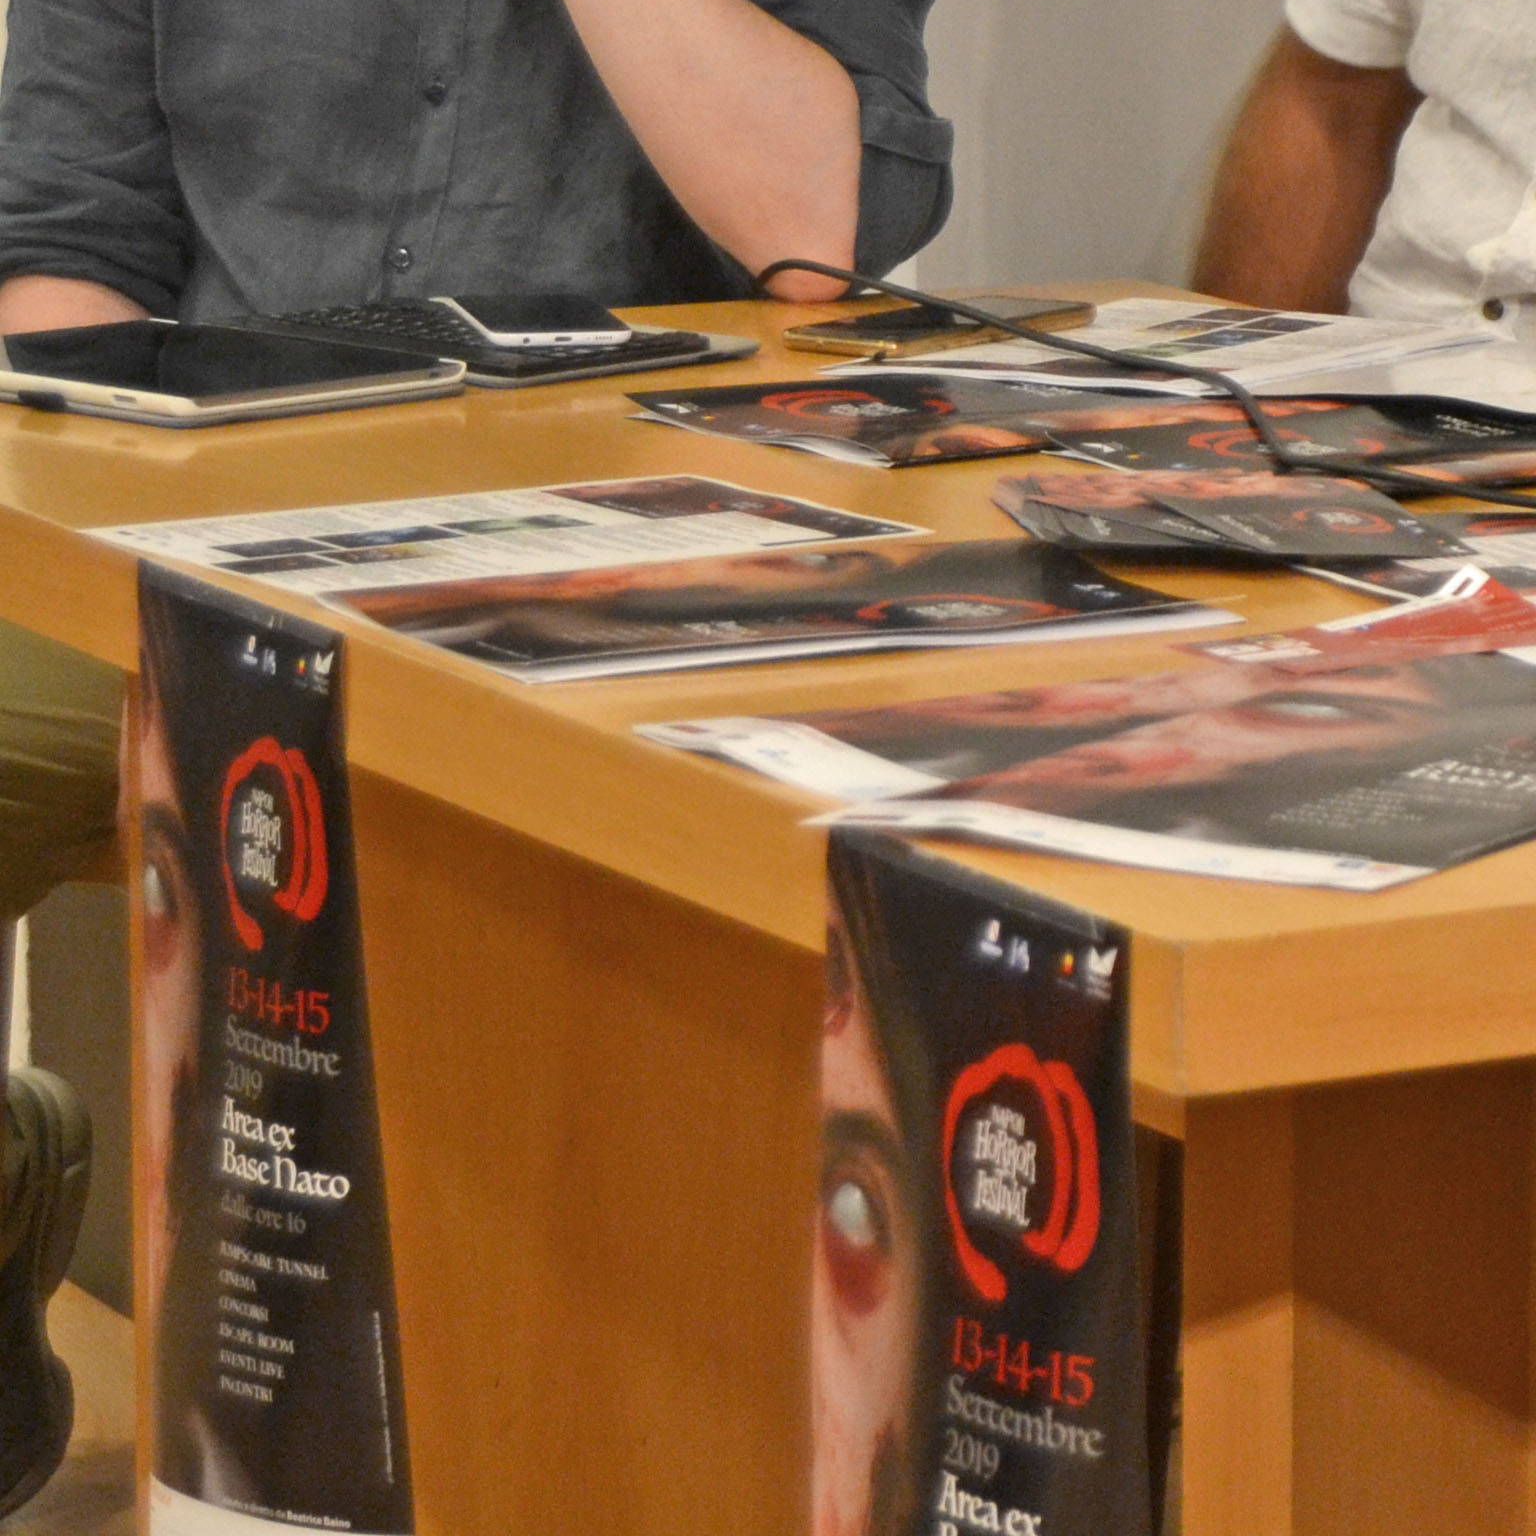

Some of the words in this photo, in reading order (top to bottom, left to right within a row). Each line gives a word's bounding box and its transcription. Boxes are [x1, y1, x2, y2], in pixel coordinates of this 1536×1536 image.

[228, 967, 331, 1035] 13-14-15
[225, 1014, 341, 1077] Settembre
[223, 1059, 263, 1100] 2019
[222, 1094, 264, 1143] Area
[268, 1122, 296, 1152] ex
[222, 1137, 270, 1186] Base
[274, 1155, 350, 1200] Nato
[256, 1208, 283, 1230] ore
[286, 1212, 307, 1235] 16
[218, 1268, 257, 1292] CINEMA
[276, 1257, 330, 1281] TUNNEL
[257, 1331, 295, 1355] ROOM
[953, 1316, 1095, 1407] 13-14-15
[219, 1374, 273, 1403] INCONTRI
[259, 1360, 286, 1379] LIVE
[947, 1374, 1106, 1458] Settembre
[945, 1427, 1000, 1479] 2019
[287, 1510, 323, 1525] Beatrice
[937, 1469, 1001, 1532] Area
